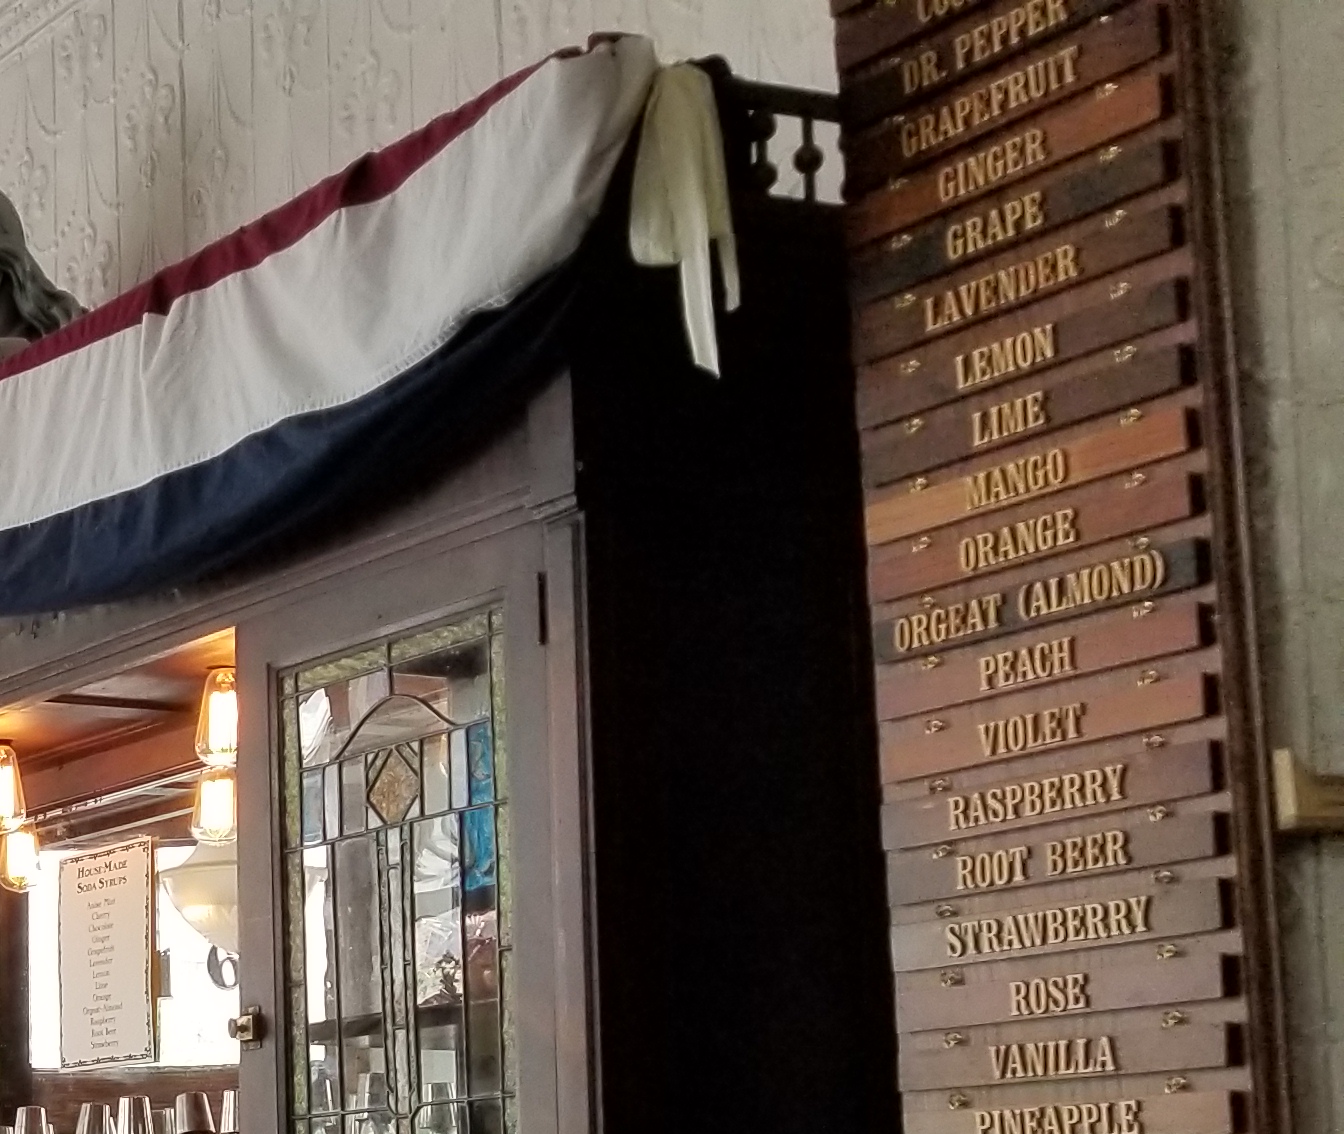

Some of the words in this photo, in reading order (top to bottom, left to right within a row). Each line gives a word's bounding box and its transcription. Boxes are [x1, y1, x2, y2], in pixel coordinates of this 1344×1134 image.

[902, 51, 947, 94] DR.
[954, 0, 1068, 70] PEPPER
[902, 45, 1079, 158] GRAPEFRUIT
[938, 128, 1046, 202] GINGER
[947, 191, 1043, 260] GRAPE
[924, 244, 1078, 332] LAVENDER
[954, 323, 1055, 390] LEMON
[972, 391, 1045, 447] LIME
[966, 449, 1065, 510] MANGO
[961, 508, 1077, 572] ORANGE
[895, 593, 1002, 652] ORGEAT
[1018, 550, 1165, 621] (ALMOND)
[979, 636, 1076, 691] PEACH
[979, 702, 1085, 757] VIOLET
[948, 764, 1125, 830] RASPBERRY
[76, 882, 97, 894] SODA
[98, 876, 128, 889] SYRUPS
[956, 845, 1029, 890] ROOT
[1047, 830, 1128, 877] BEER
[946, 895, 1150, 957] STRAWBERRY
[1010, 973, 1087, 1016] ROSE
[989, 1036, 1116, 1079] VANILLA
